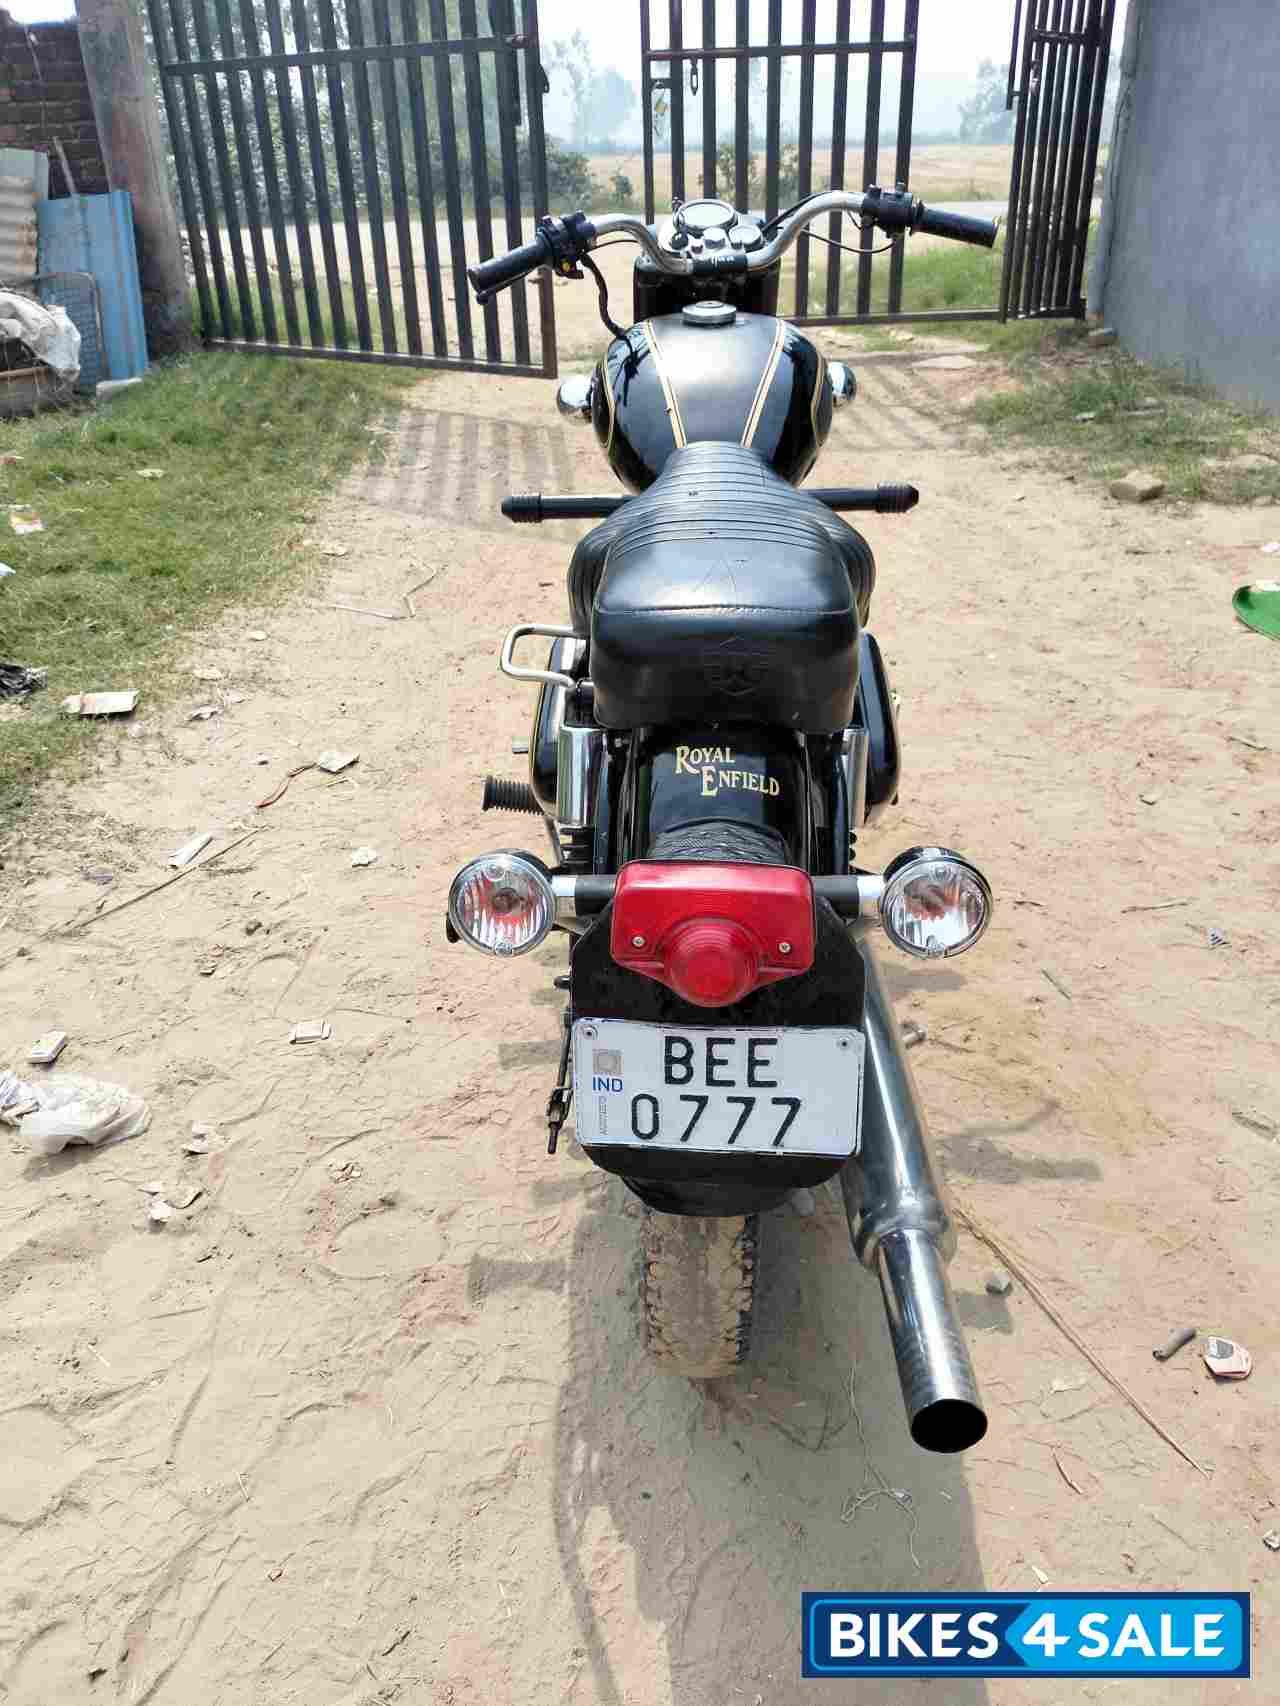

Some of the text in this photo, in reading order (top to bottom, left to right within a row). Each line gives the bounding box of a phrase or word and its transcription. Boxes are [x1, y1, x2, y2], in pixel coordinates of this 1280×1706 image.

[592, 1077, 623, 1092] IND
[664, 1036, 778, 1087] BEE
[631, 1093, 802, 1147] 0777
